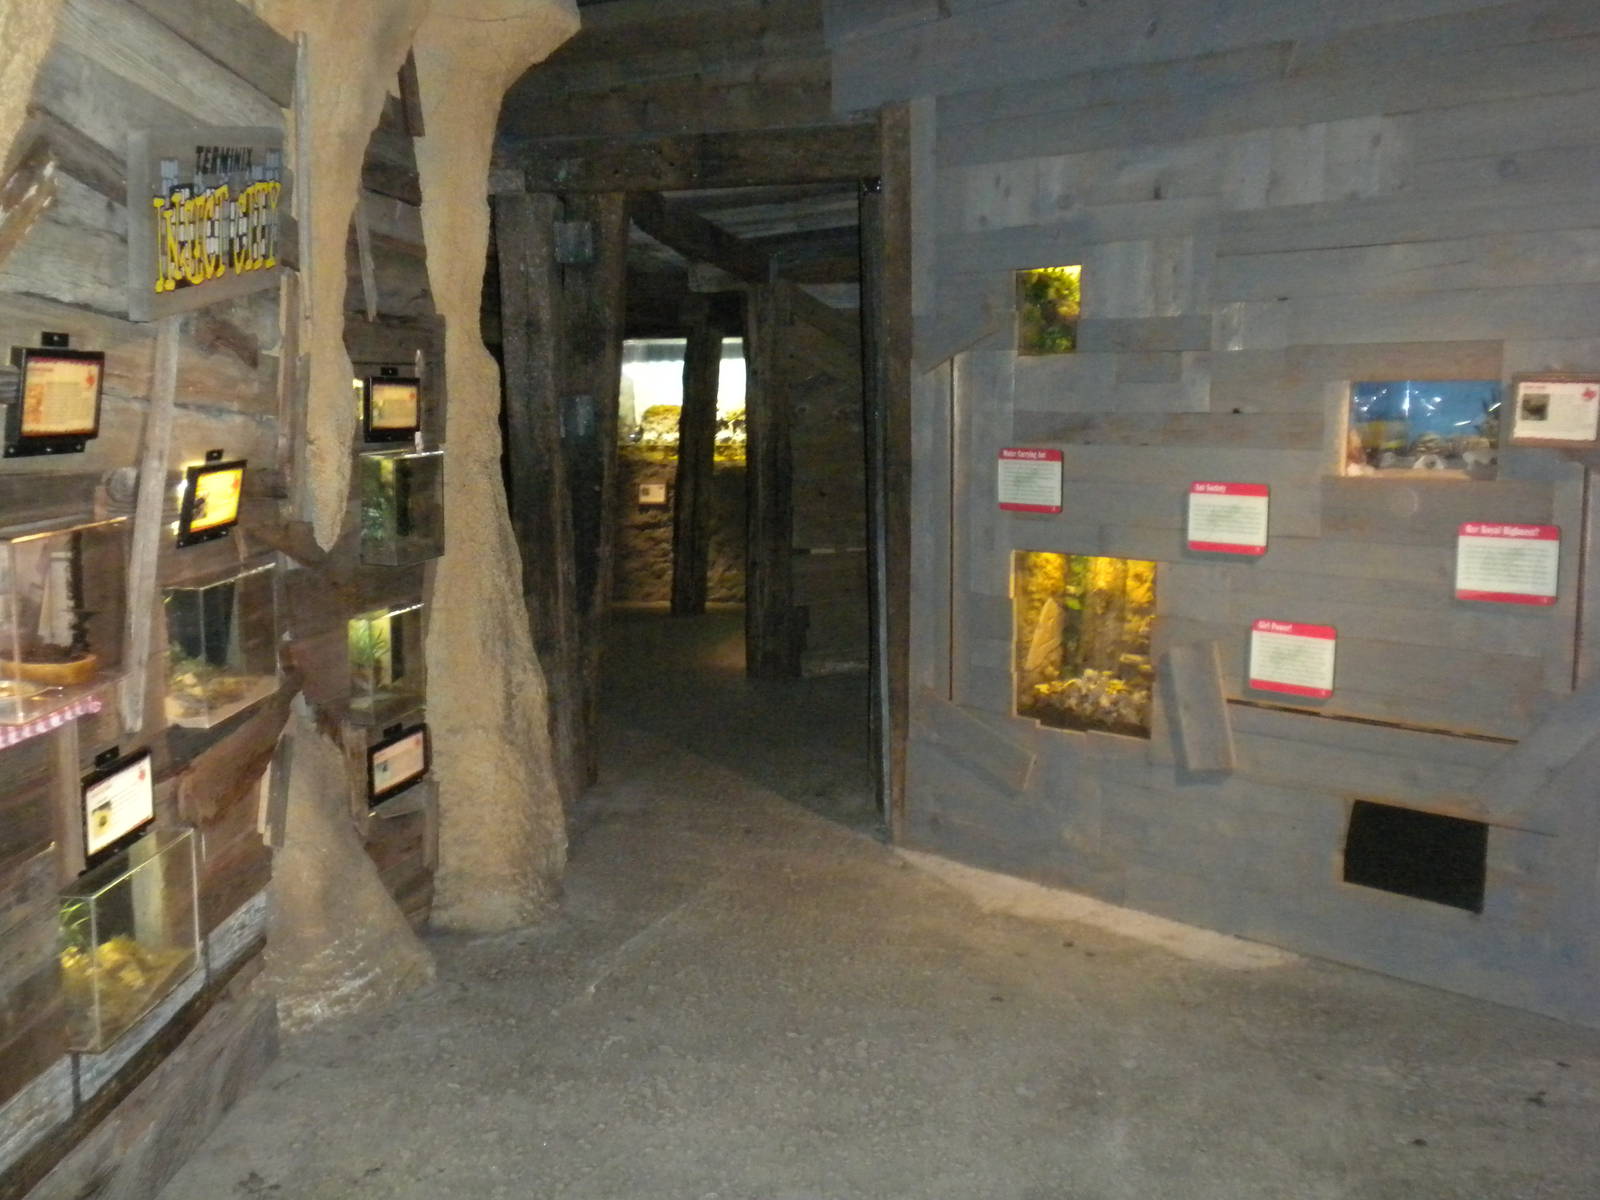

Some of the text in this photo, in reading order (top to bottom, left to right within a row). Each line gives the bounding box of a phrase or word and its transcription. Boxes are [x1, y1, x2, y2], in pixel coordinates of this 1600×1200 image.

[196, 145, 253, 174] TERMINIX
[153, 181, 281, 293] INSECT CITY
